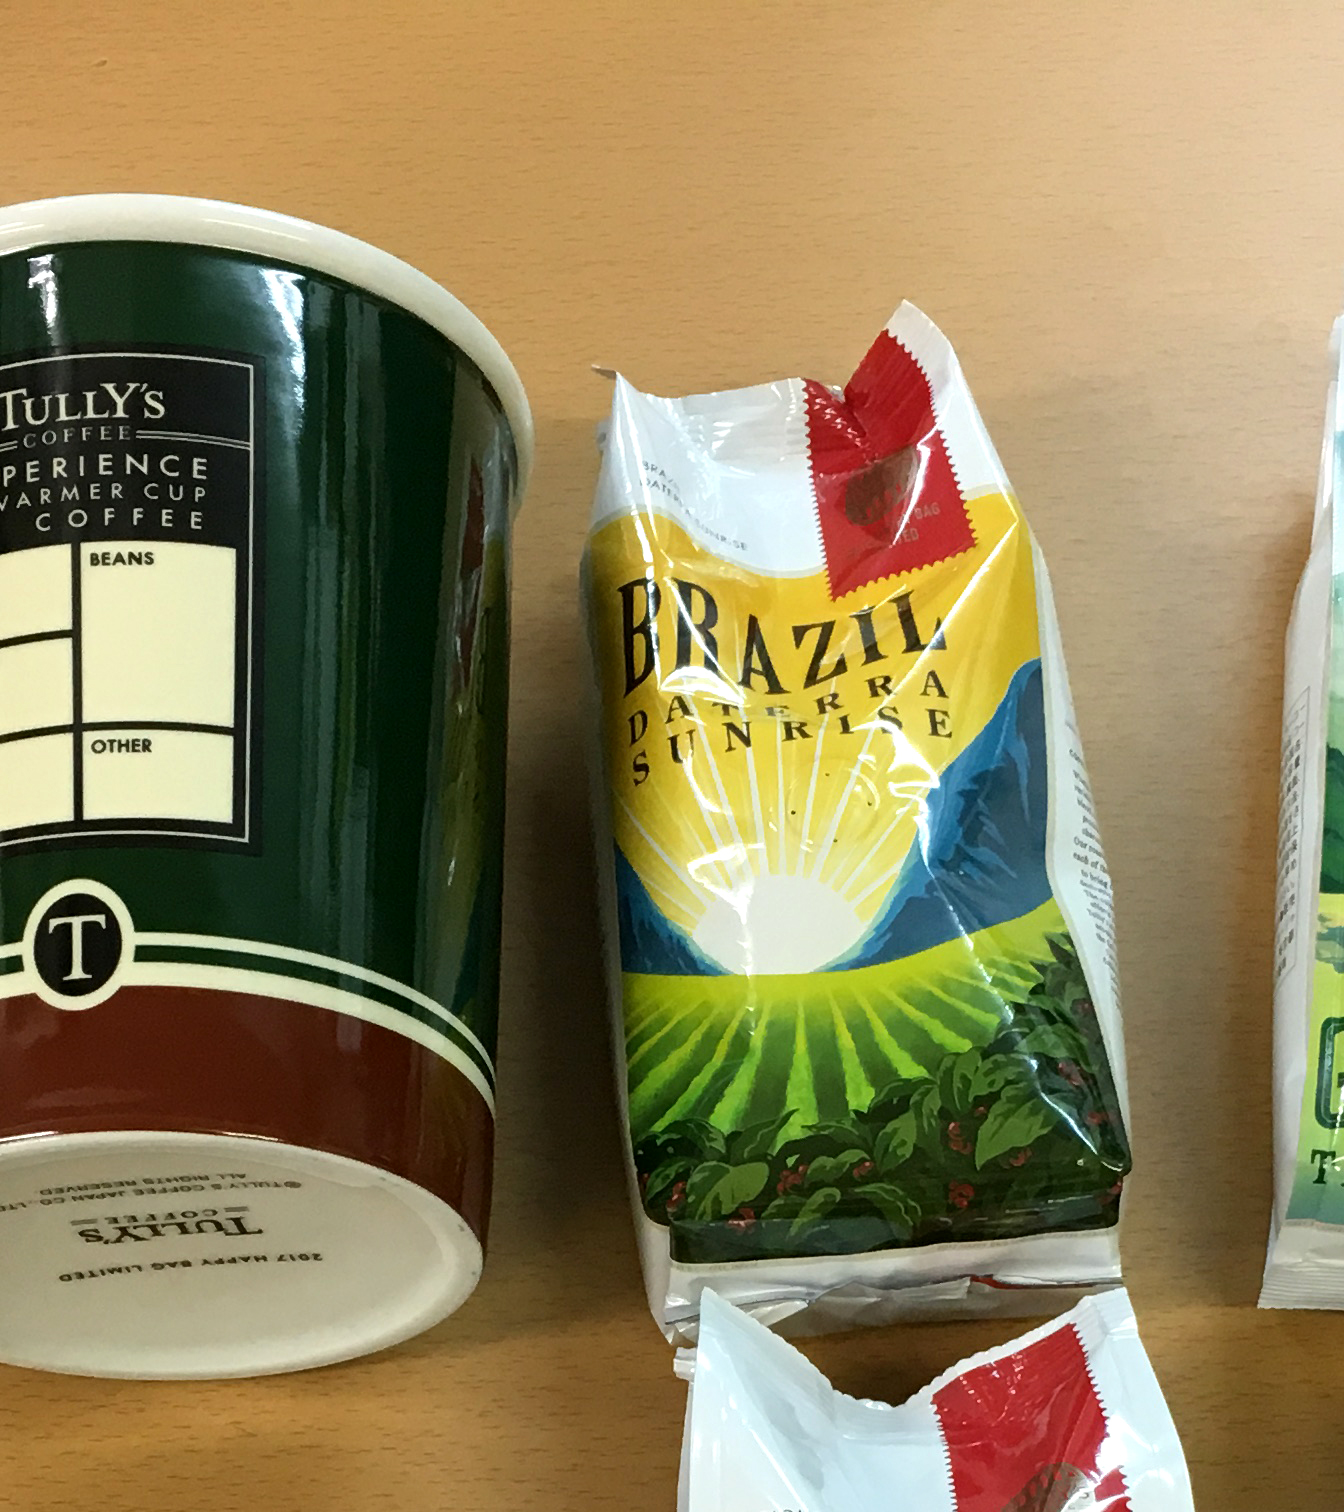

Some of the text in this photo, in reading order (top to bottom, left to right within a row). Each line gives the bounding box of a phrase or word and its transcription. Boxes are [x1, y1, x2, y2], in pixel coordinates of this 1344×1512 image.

[23, 425, 131, 448] COFFEE
[144, 483, 206, 503] CUP
[35, 508, 203, 531] COFFEE
[90, 551, 154, 567] BEANS
[617, 576, 947, 699] BRAZIL
[628, 669, 948, 746] DATERRA
[91, 738, 152, 754] OTHER
[633, 705, 953, 788] SUNRISE
[48, 914, 107, 981] T
[104, 1208, 218, 1224] COFFEE
[78, 1216, 263, 1244] TULLY'S
[58, 1252, 323, 1282] 2017 HAPPY BAG LIMITED
